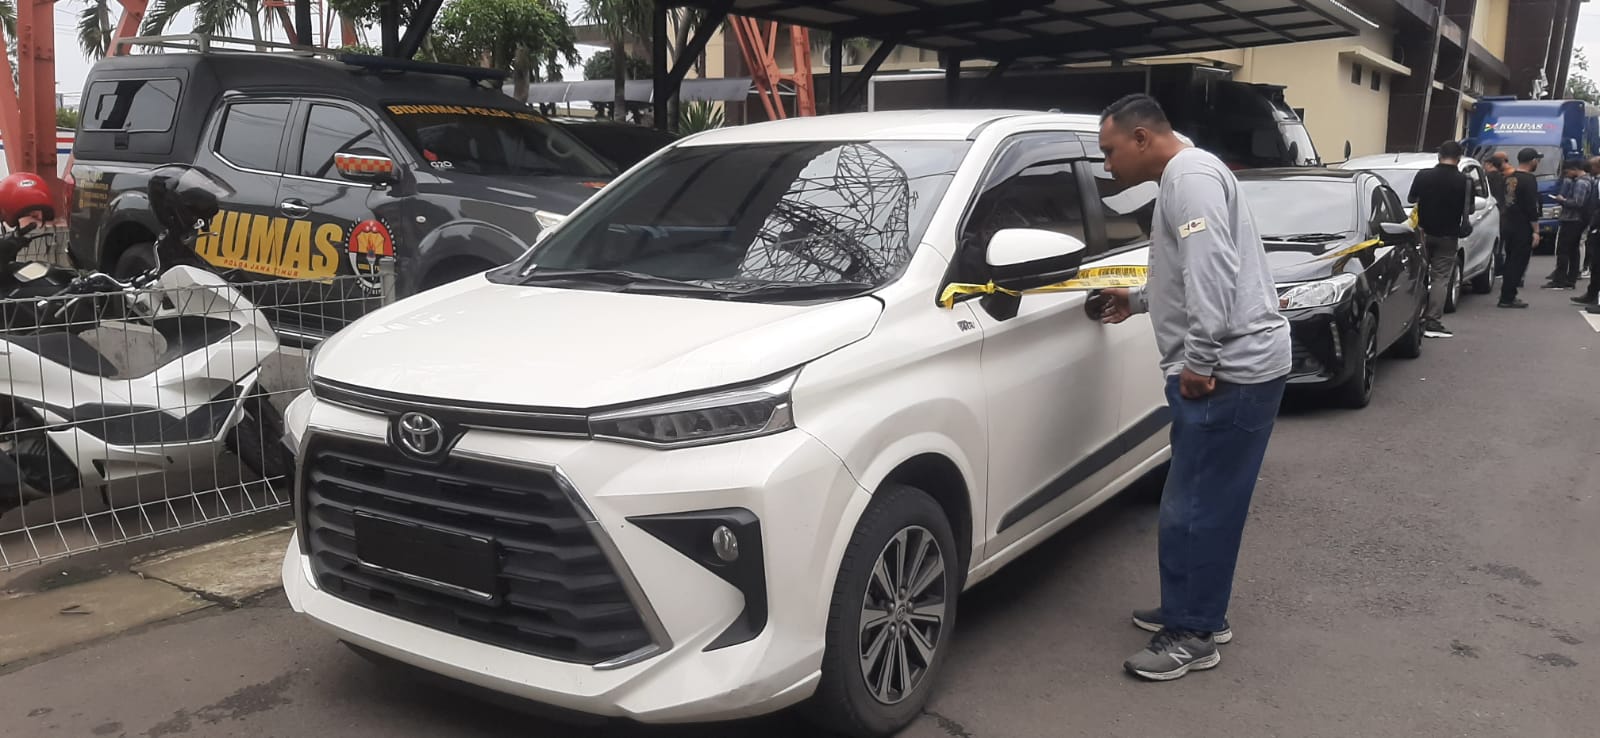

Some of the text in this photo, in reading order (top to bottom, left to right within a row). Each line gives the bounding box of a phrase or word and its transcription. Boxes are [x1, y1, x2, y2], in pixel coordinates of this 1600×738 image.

[387, 105, 467, 115] BIDHUMAS
[466, 106, 513, 117] POLDA
[223, 259, 299, 277] POLDA JAWA TIMUR
